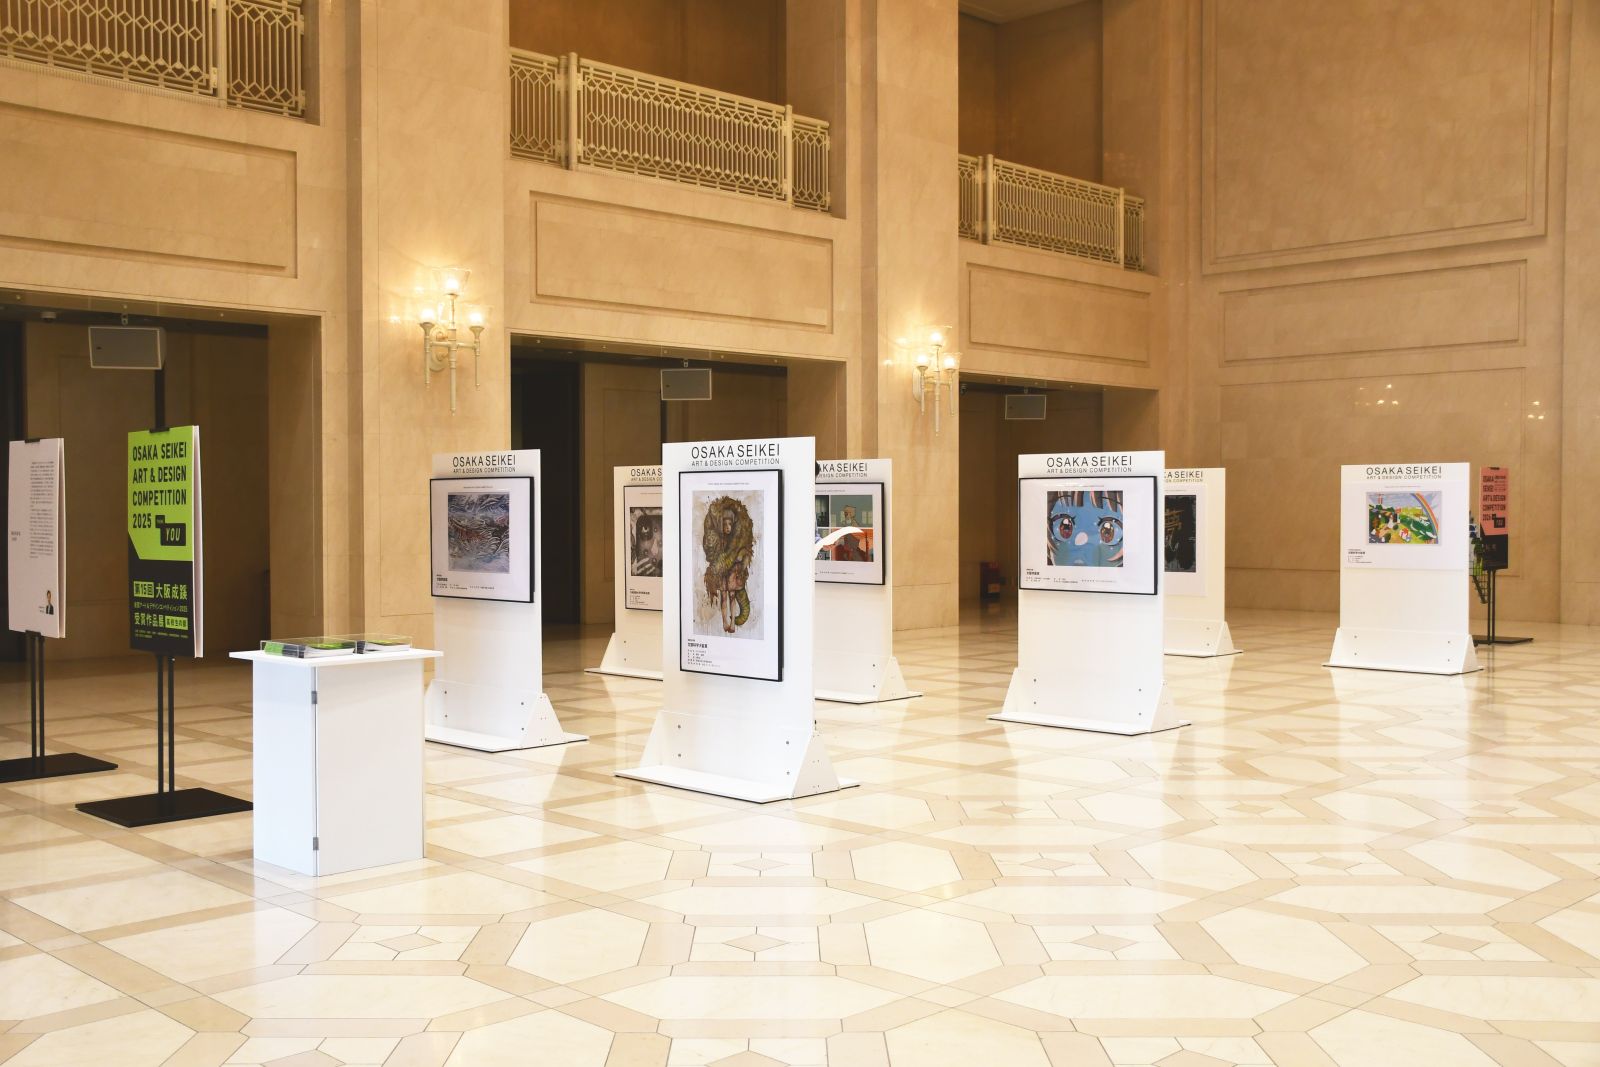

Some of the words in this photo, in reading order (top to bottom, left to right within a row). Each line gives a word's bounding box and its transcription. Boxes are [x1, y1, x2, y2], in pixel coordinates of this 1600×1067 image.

[133, 444, 158, 461] OSAKA
[161, 442, 186, 459] SEIKEI
[691, 445, 734, 459] OSAKA
[737, 443, 780, 457] SEIKEI
[453, 455, 483, 467] OSAKA
[486, 454, 515, 466] SEIKEI
[735, 458, 780, 466] COMPETITION
[837, 462, 868, 472] SEIKEI
[1047, 457, 1089, 468] OSAKA
[1092, 455, 1132, 467] SEIKEI
[133, 467, 147, 484] ART
[150, 467, 155, 483] &
[158, 465, 186, 482] DESIGN
[631, 468, 656, 476] OSAKA
[1174, 470, 1203, 478] SEIKEI
[1366, 467, 1403, 475] OSAKA
[1405, 466, 1442, 474] SEIKEI
[133, 489, 186, 506] COMPETITION
[133, 513, 151, 528] 2025
[166, 527, 181, 541] YOU
